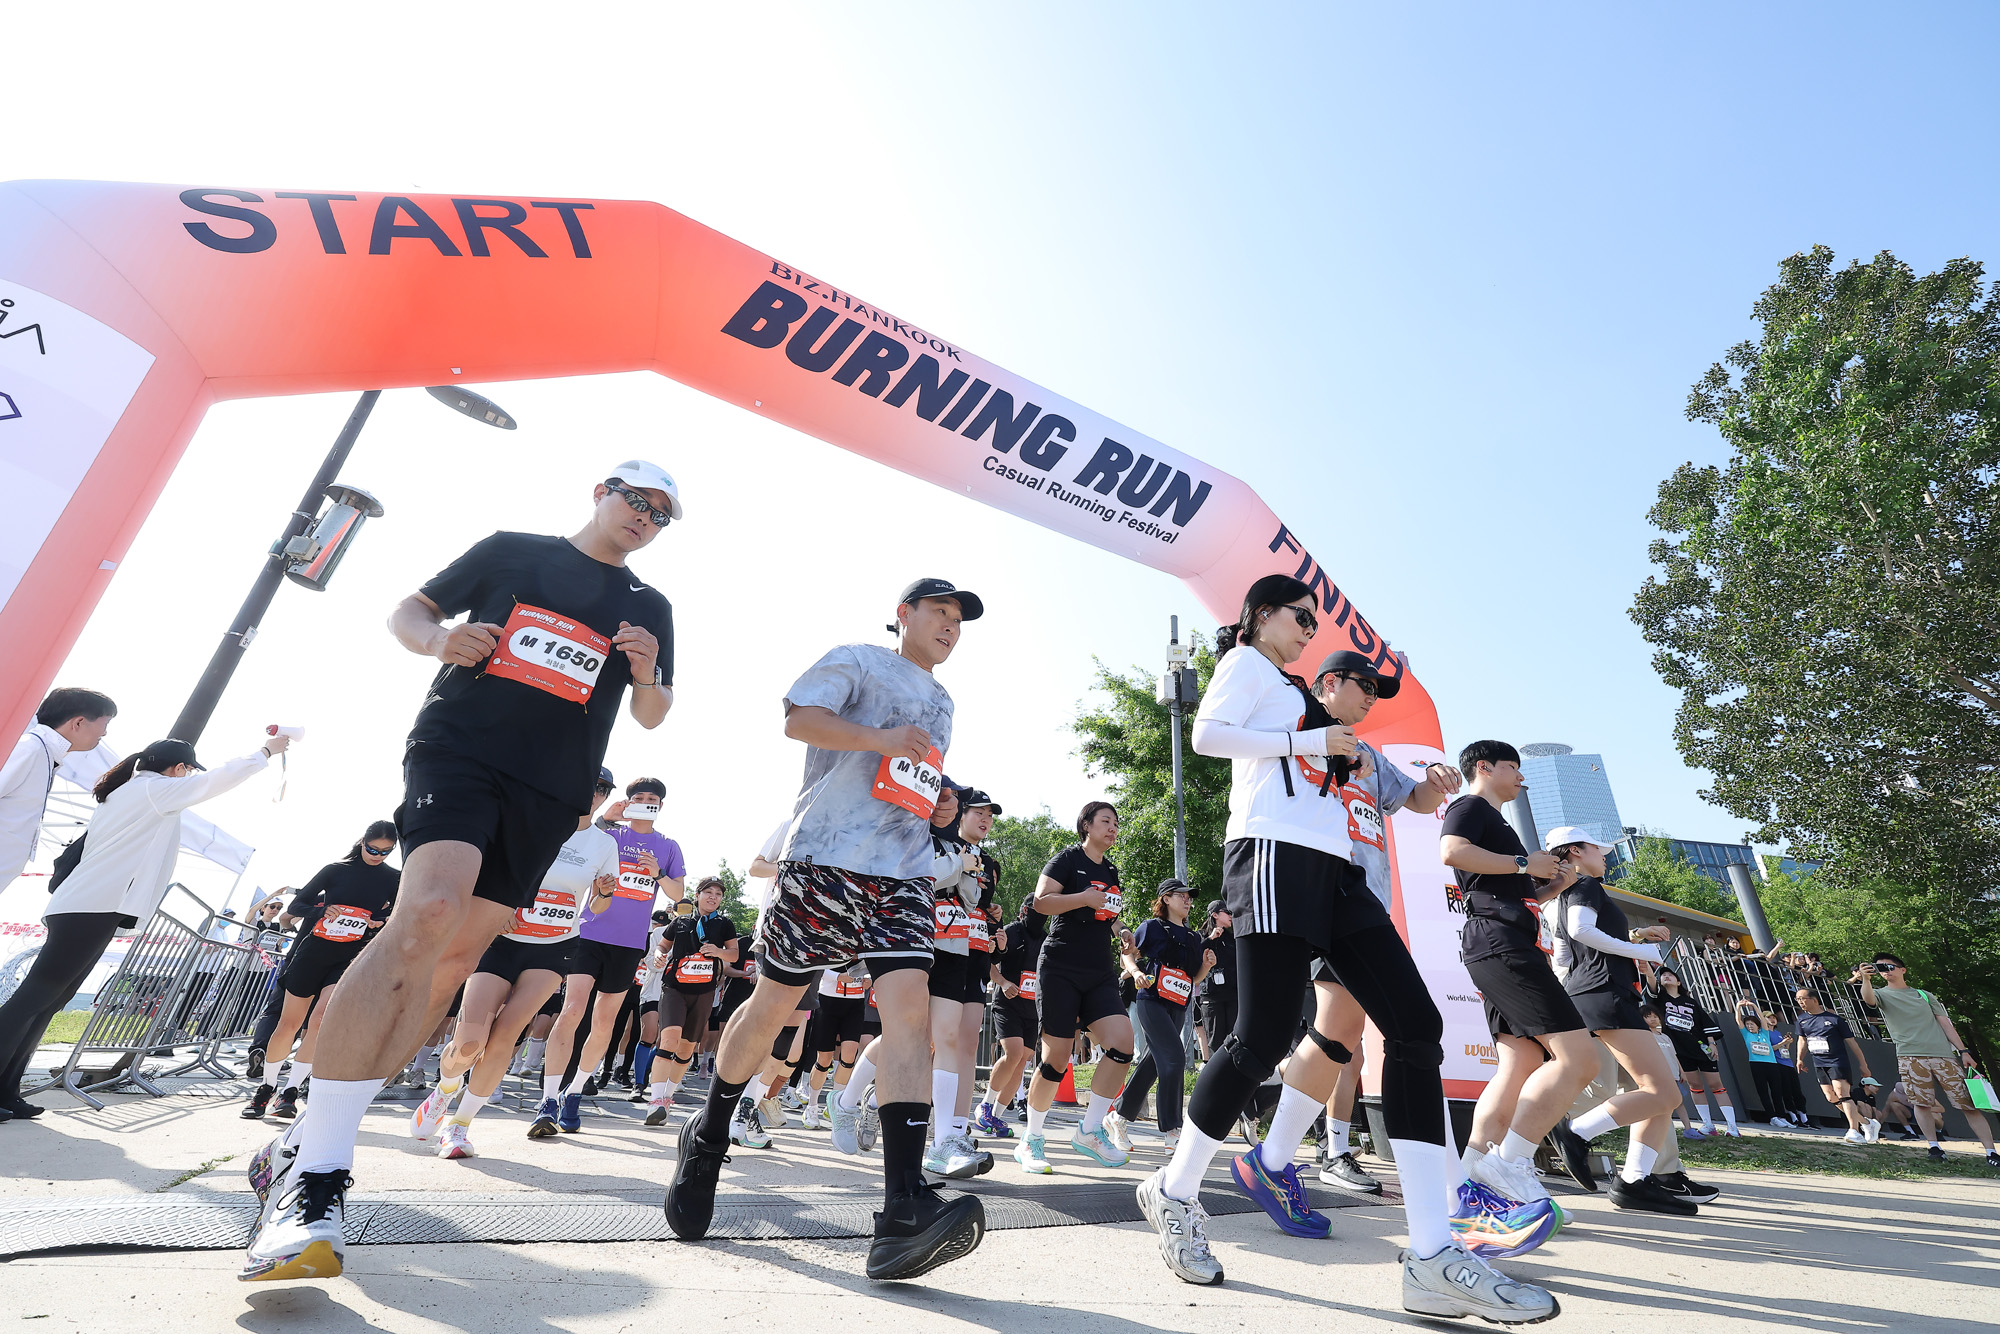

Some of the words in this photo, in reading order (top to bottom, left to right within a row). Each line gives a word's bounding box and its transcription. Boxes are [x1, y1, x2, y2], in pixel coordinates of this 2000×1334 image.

[179, 188, 595, 258] START
[720, 280, 1077, 472] BURNING
[1072, 437, 1213, 528] RUN
[983, 456, 1046, 491] Casual
[1046, 481, 1117, 522] Running
[1117, 511, 1179, 544] Festival
[1268, 522, 1404, 680] FINISH
[518, 609, 557, 624] BURNING
[556, 619, 576, 632] RUN
[590, 635, 607, 647] 10km
[519, 635, 539, 648] M
[544, 641, 599, 672] 1650
[897, 760, 910, 773] M
[913, 766, 941, 793] 1649
[1354, 806, 1363, 816] M
[1363, 808, 1382, 827] 2722
[632, 876, 655, 888] 1651
[337, 918, 366, 929] 4307
[527, 907, 538, 915] W
[539, 907, 575, 919] 3896
[1173, 981, 1191, 992] 4462
[1446, 994, 1466, 1002] World
[1466, 995, 1481, 1003] Vision
